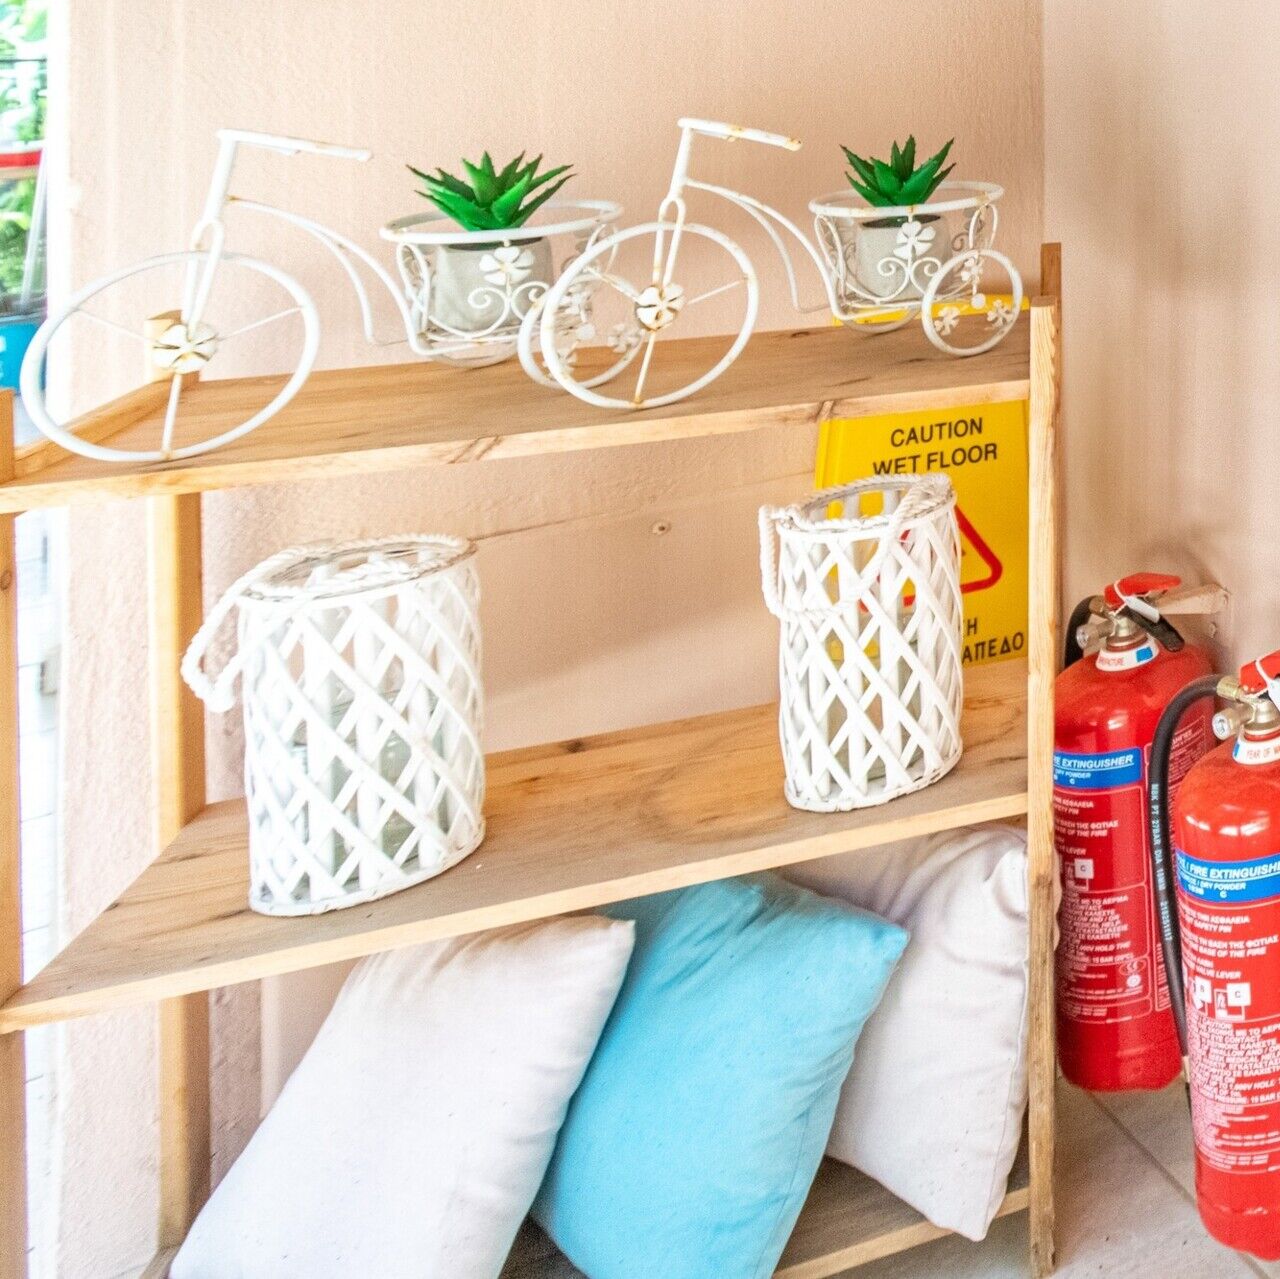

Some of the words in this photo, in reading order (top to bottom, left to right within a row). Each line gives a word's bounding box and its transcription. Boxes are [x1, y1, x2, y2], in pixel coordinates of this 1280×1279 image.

[890, 417, 983, 448] CAUTION
[873, 455, 921, 476] WET
[926, 443, 998, 472] FLOOR
[962, 632, 1024, 664] ΑΠΕΔΟ
[1062, 754, 1134, 769] EXTINGUISHER
[1190, 863, 1208, 878] FIRE
[1214, 882, 1247, 891] POWDER
[1216, 970, 1241, 980] LEVER
[1235, 990, 1242, 999] C
